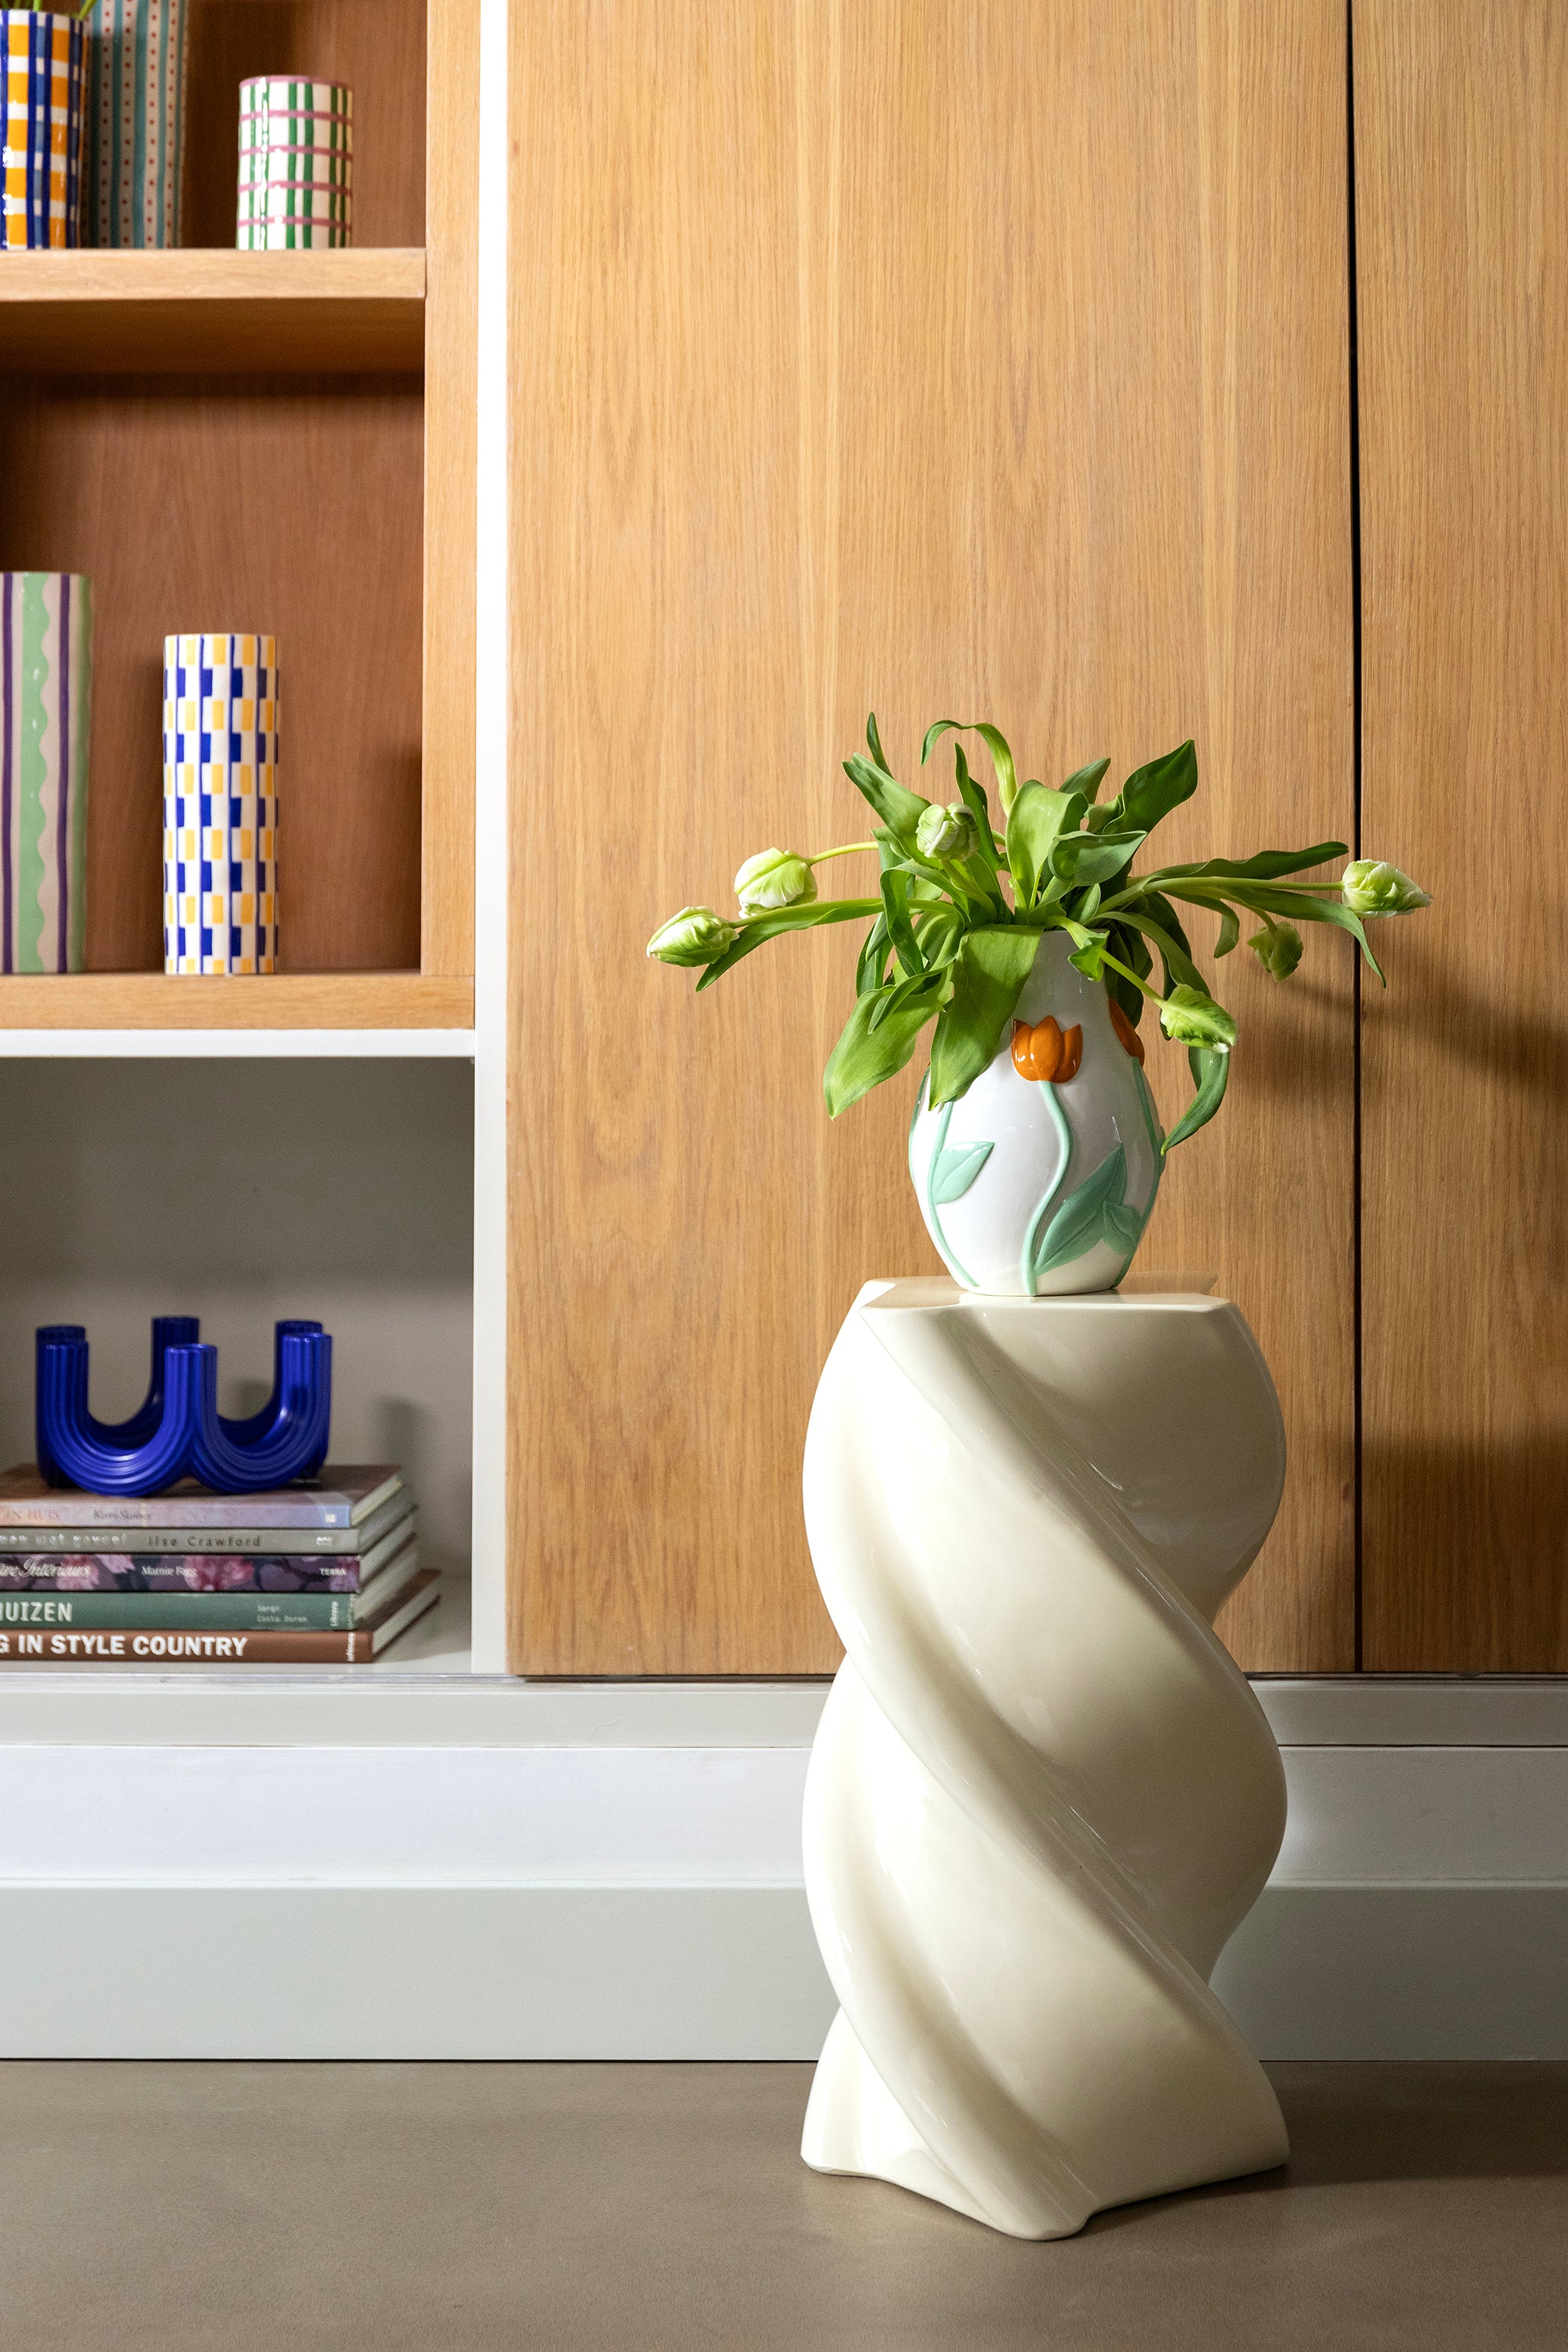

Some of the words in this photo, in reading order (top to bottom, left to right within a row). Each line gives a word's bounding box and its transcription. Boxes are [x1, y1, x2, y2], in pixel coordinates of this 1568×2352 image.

[188, 1536, 260, 1547] Crawford
[142, 1566, 174, 1576] Marnie
[18, 1634, 43, 1655] IN
[50, 1634, 127, 1655] STYLE
[133, 1636, 249, 1657] COUNTRY
